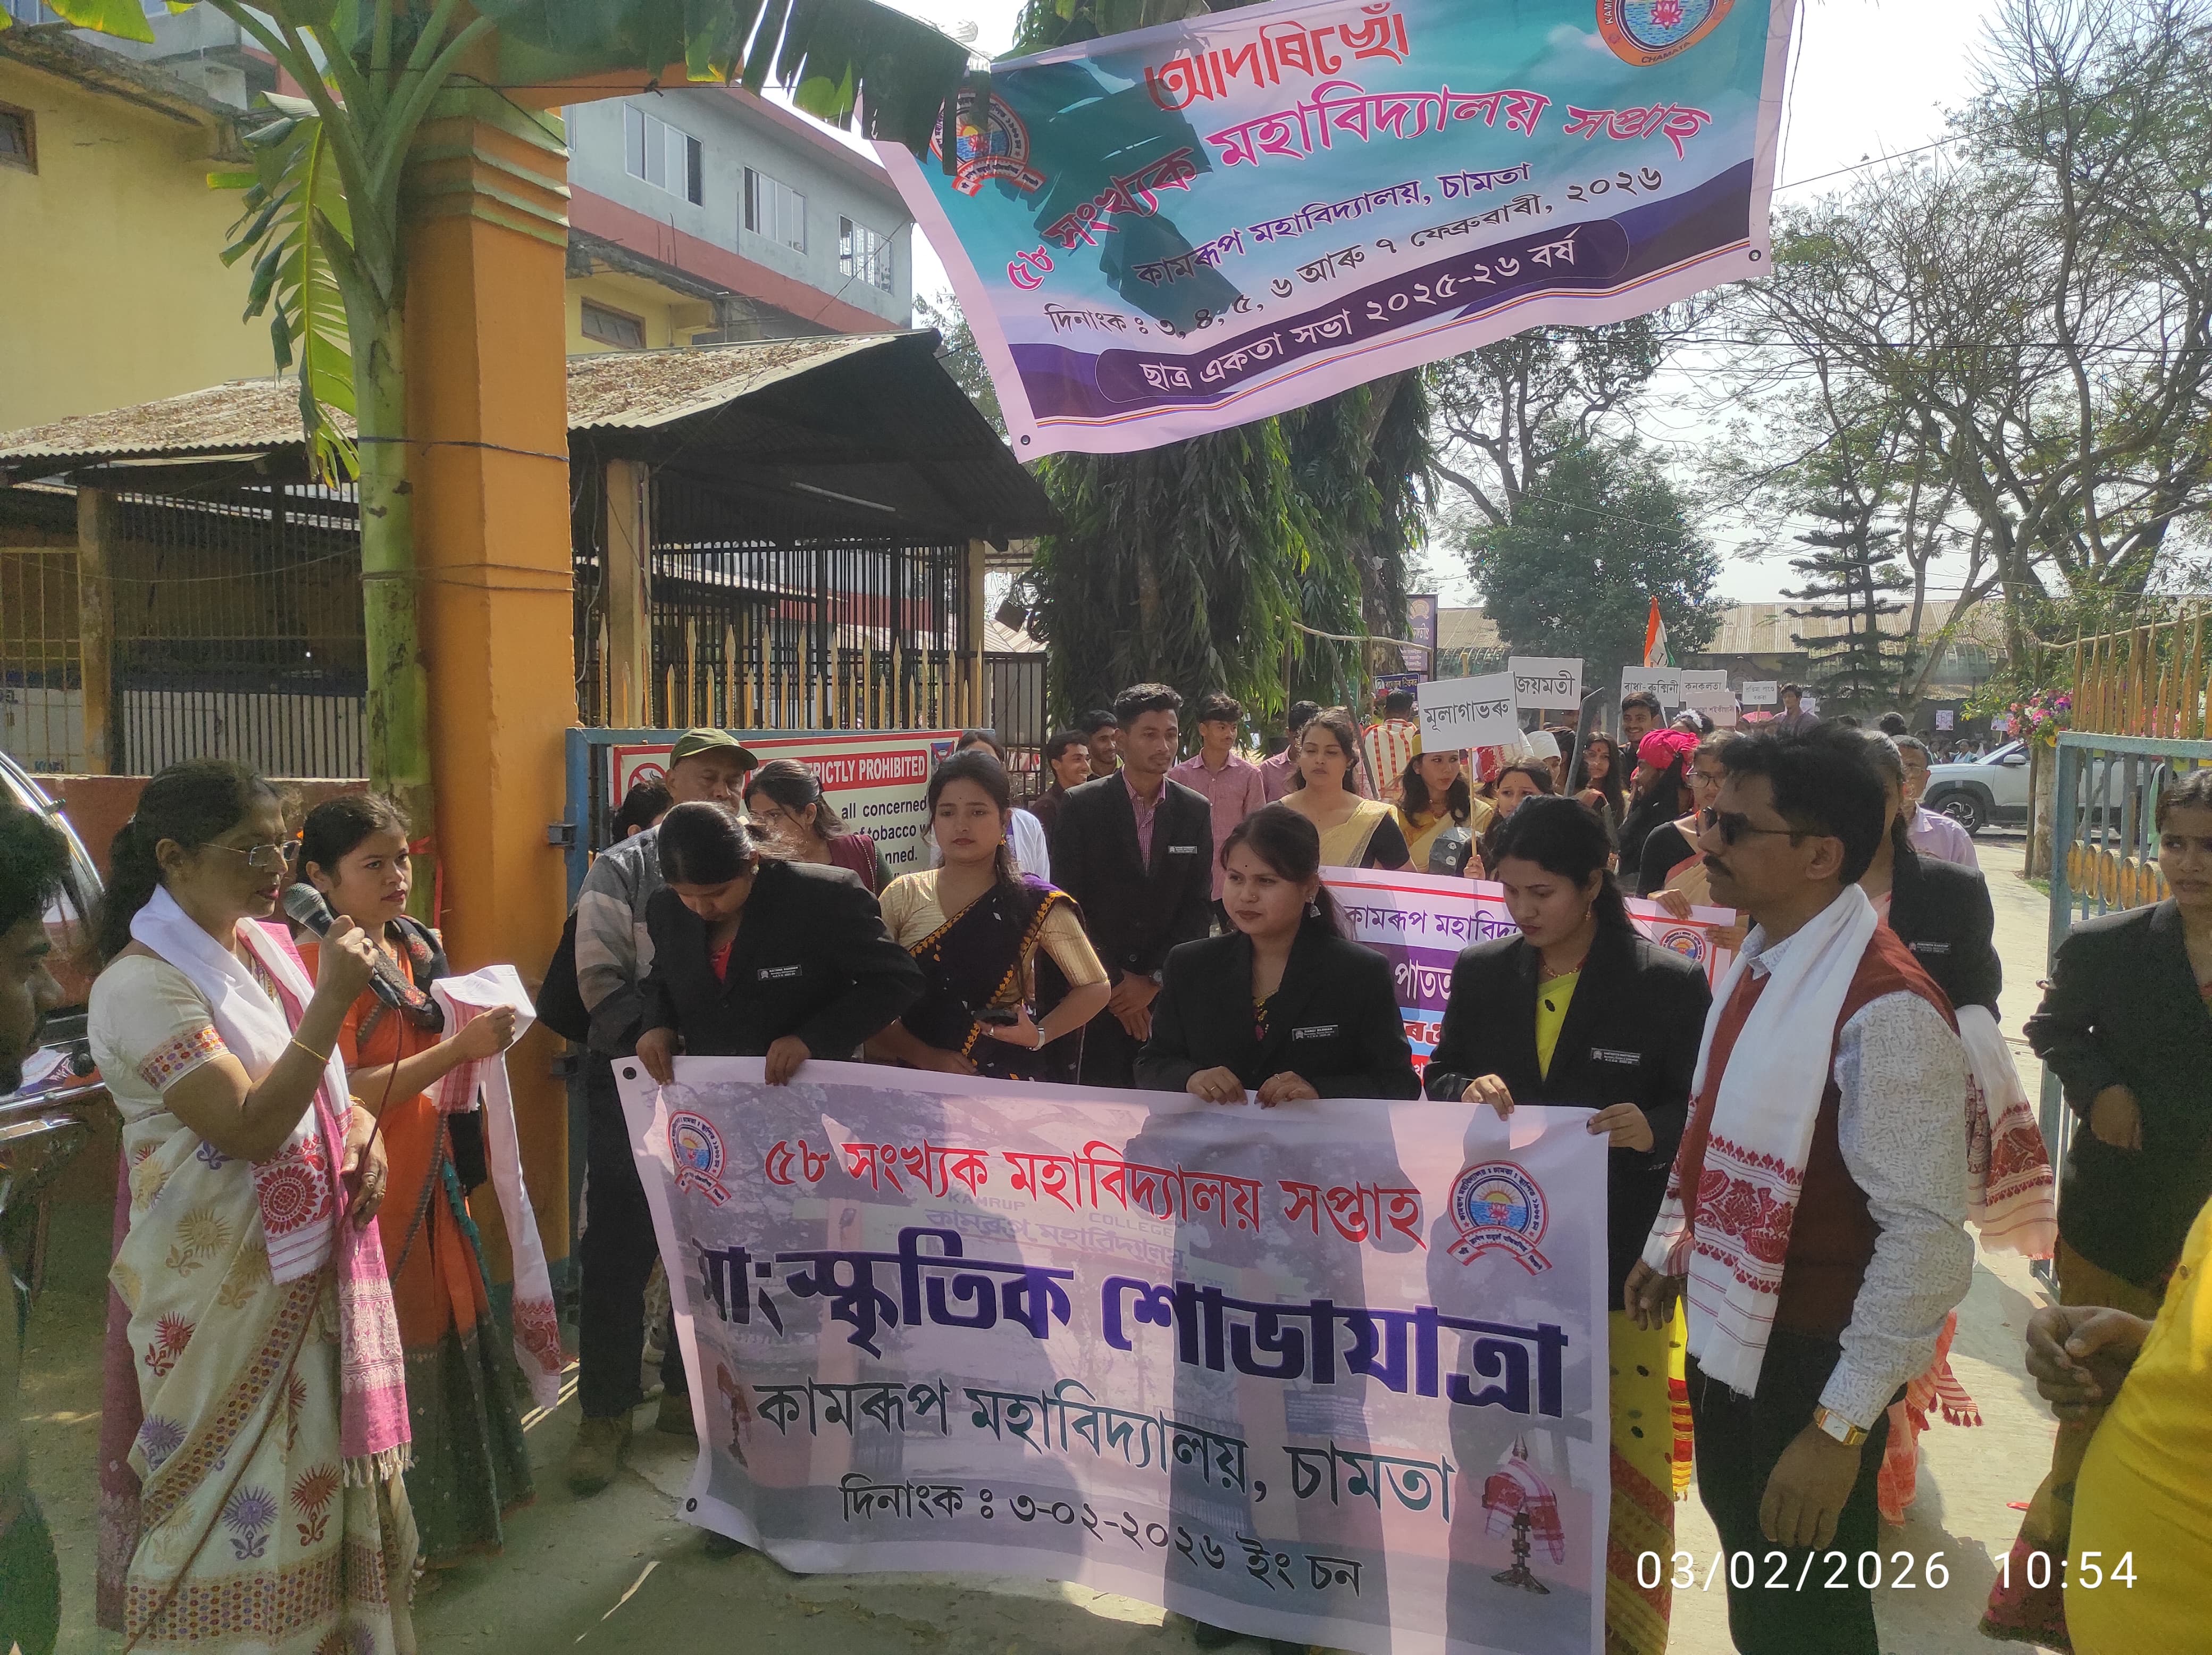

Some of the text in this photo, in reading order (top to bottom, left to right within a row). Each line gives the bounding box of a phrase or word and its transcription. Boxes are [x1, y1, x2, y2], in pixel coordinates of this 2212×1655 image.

[1641, 41, 1690, 63] CHAMATA
[1008, 80, 1712, 290] ৫৮ সংখ্যক মহাবিদ্যালয় সপ্তাহ
[1133, 228, 1245, 287] কামৰূপ
[1436, 162, 1533, 199] চামতা
[1043, 303, 1128, 335] দিনাংক
[1270, 278, 1293, 298] ৬
[1297, 242, 1364, 283] আৰু
[1376, 238, 1396, 254] ৭
[1566, 166, 1662, 204] ২০২৬
[1200, 332, 1284, 382] একতা
[1289, 308, 1353, 344] সভা
[1366, 256, 1520, 321] ২০২৫-২৬
[1515, 670, 1575, 697] জয়মতী
[1685, 682, 1722, 690] কনকলতা
[1423, 698, 1510, 732] মূলাগাভৰু
[807, 755, 925, 784] RICTLY PROHIBITED
[841, 796, 927, 820] all concerned
[885, 846, 918, 864] nned.
[1344, 905, 1428, 934] কামৰূপ
[765, 1139, 1428, 1250] ৫৮ সংখ্যক মহাবিদ্যালয় সপ্তাহ
[949, 1192, 1175, 1238] KAMRUP COLLEGE
[752, 1376, 951, 1437] কামৰূপ
[1283, 1438, 1459, 1524] চামতা
[838, 1473, 964, 1523] দিনাংক
[1010, 1494, 1224, 1570] ৩-০২-২০২৬
[1236, 1531, 1295, 1592] ইং
[1304, 1552, 1362, 1598] চন
